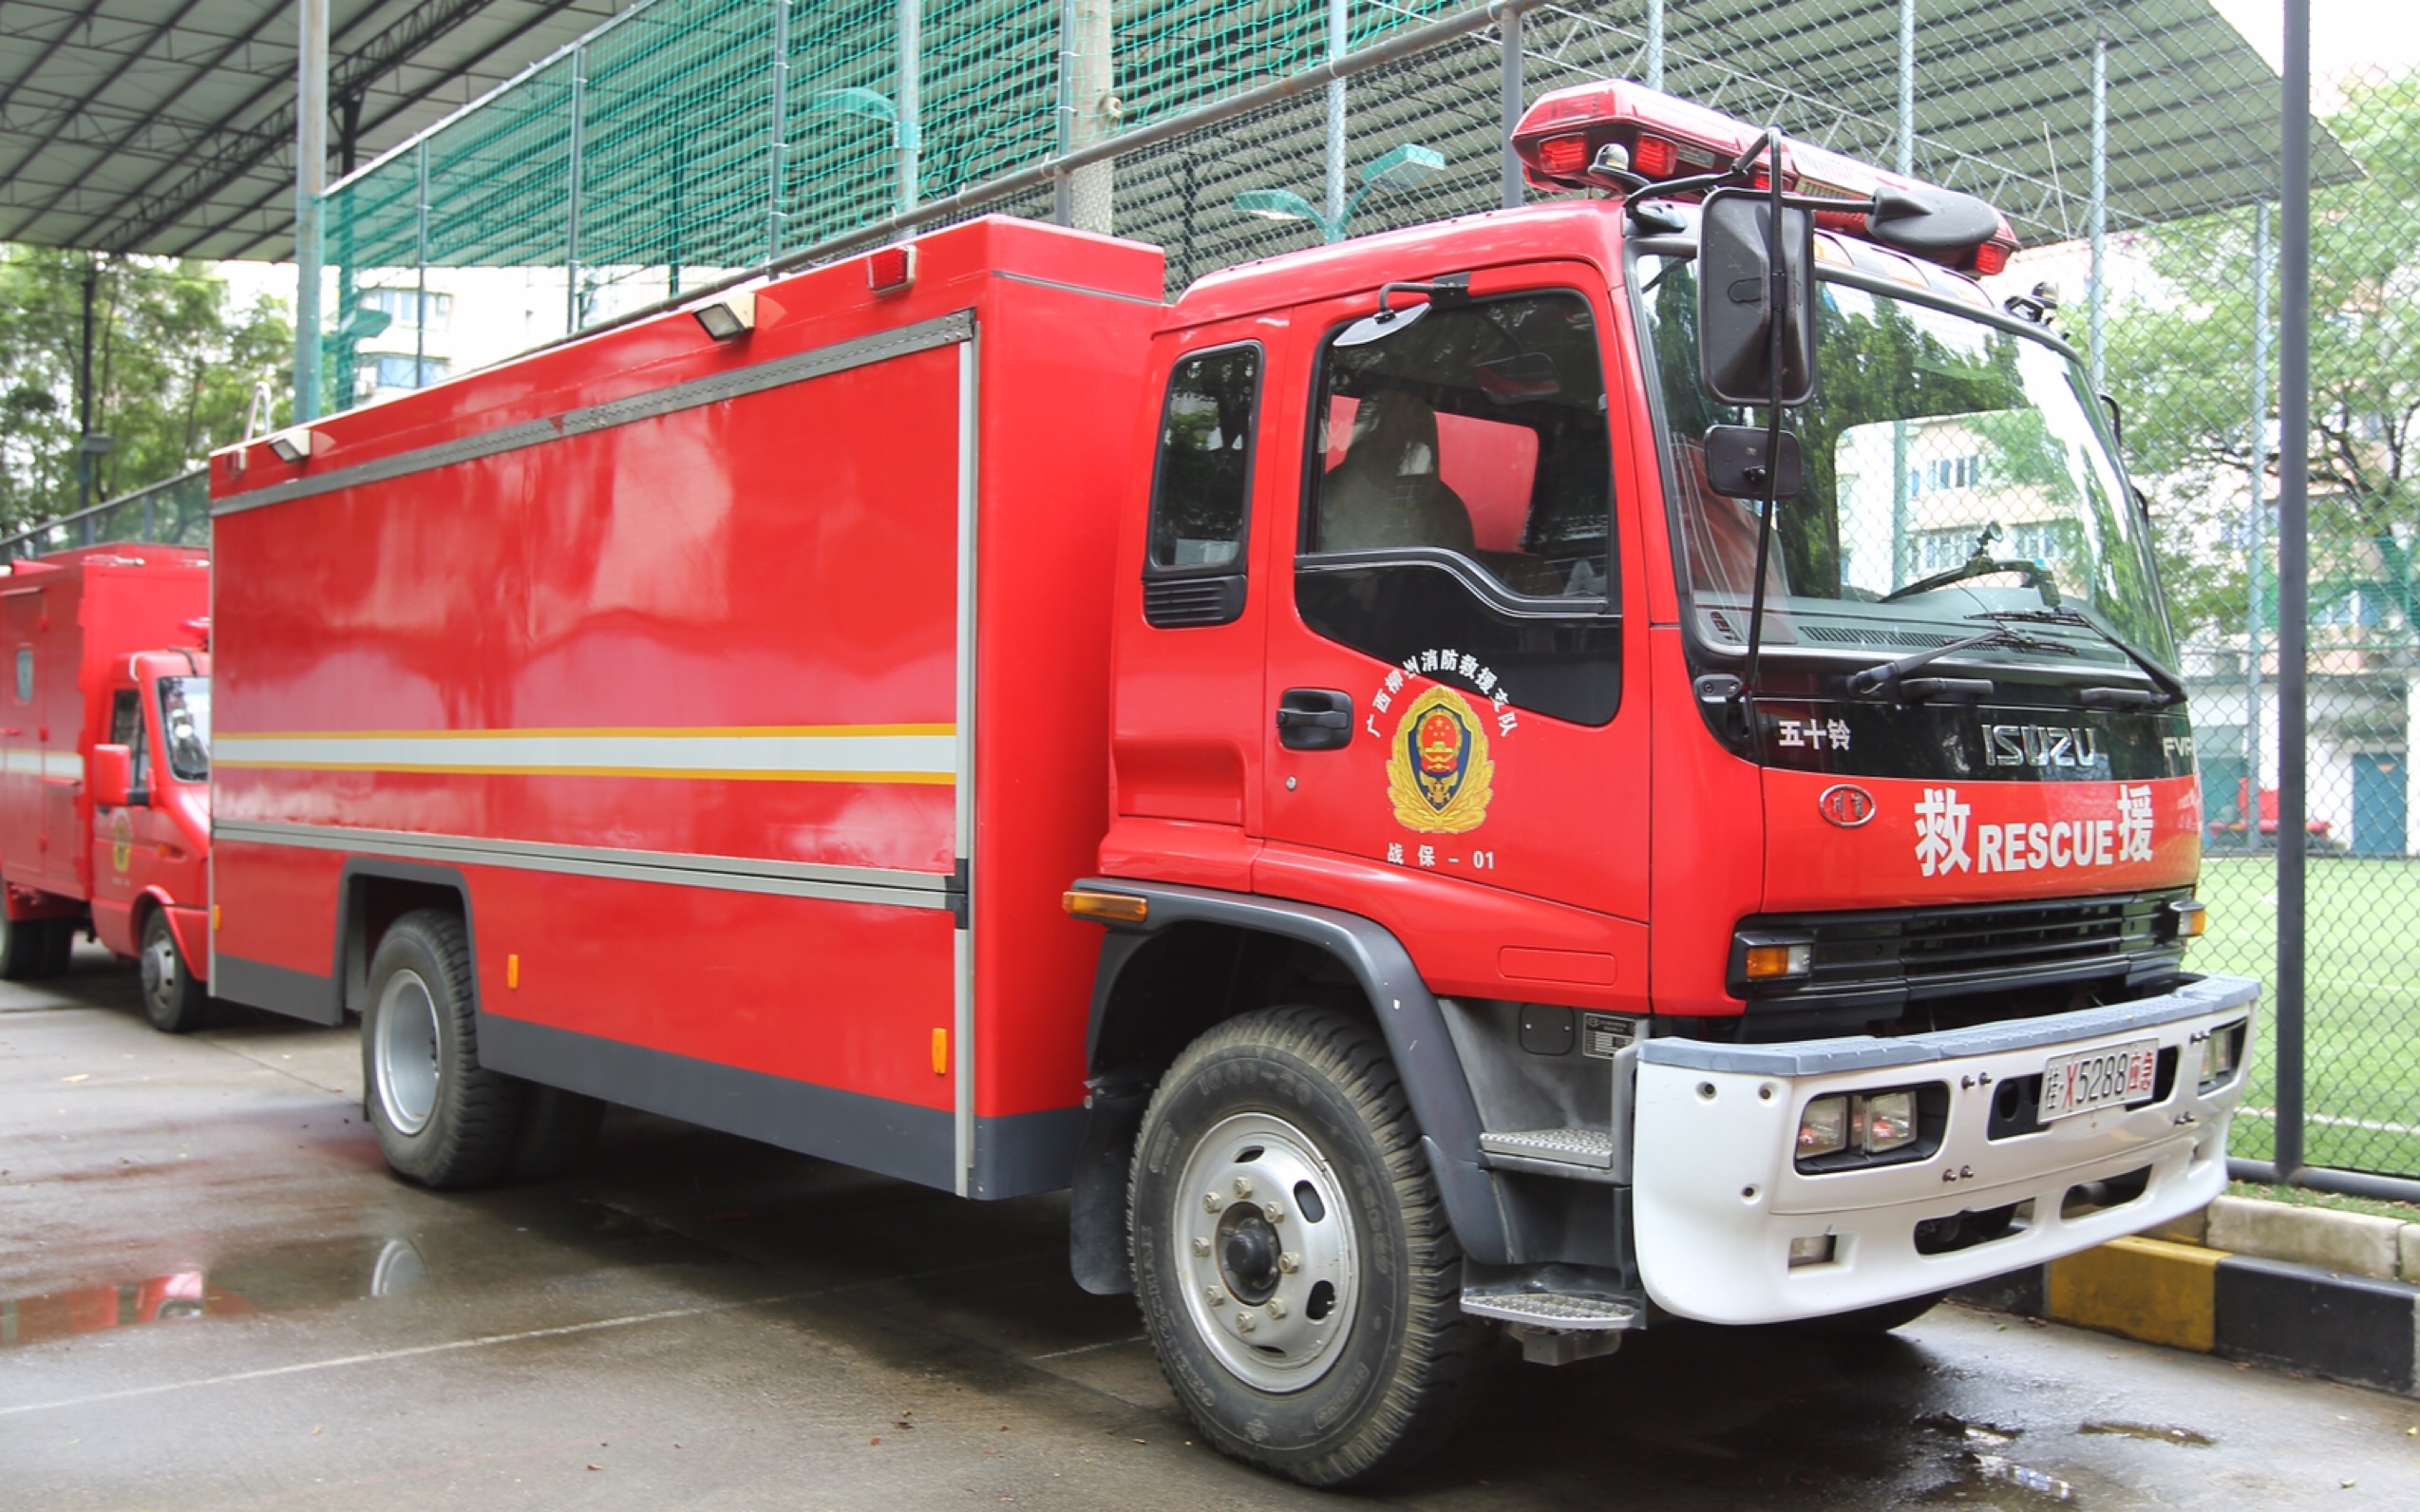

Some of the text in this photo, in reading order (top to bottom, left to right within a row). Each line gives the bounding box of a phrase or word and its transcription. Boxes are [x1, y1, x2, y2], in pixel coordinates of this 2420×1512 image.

[1366, 649, 1520, 738] 广西柳州消防救援支队
[1778, 718, 1851, 751] 五十铃
[1981, 724, 2096, 766] ISUZU
[1977, 819, 2114, 875] RESCUE
